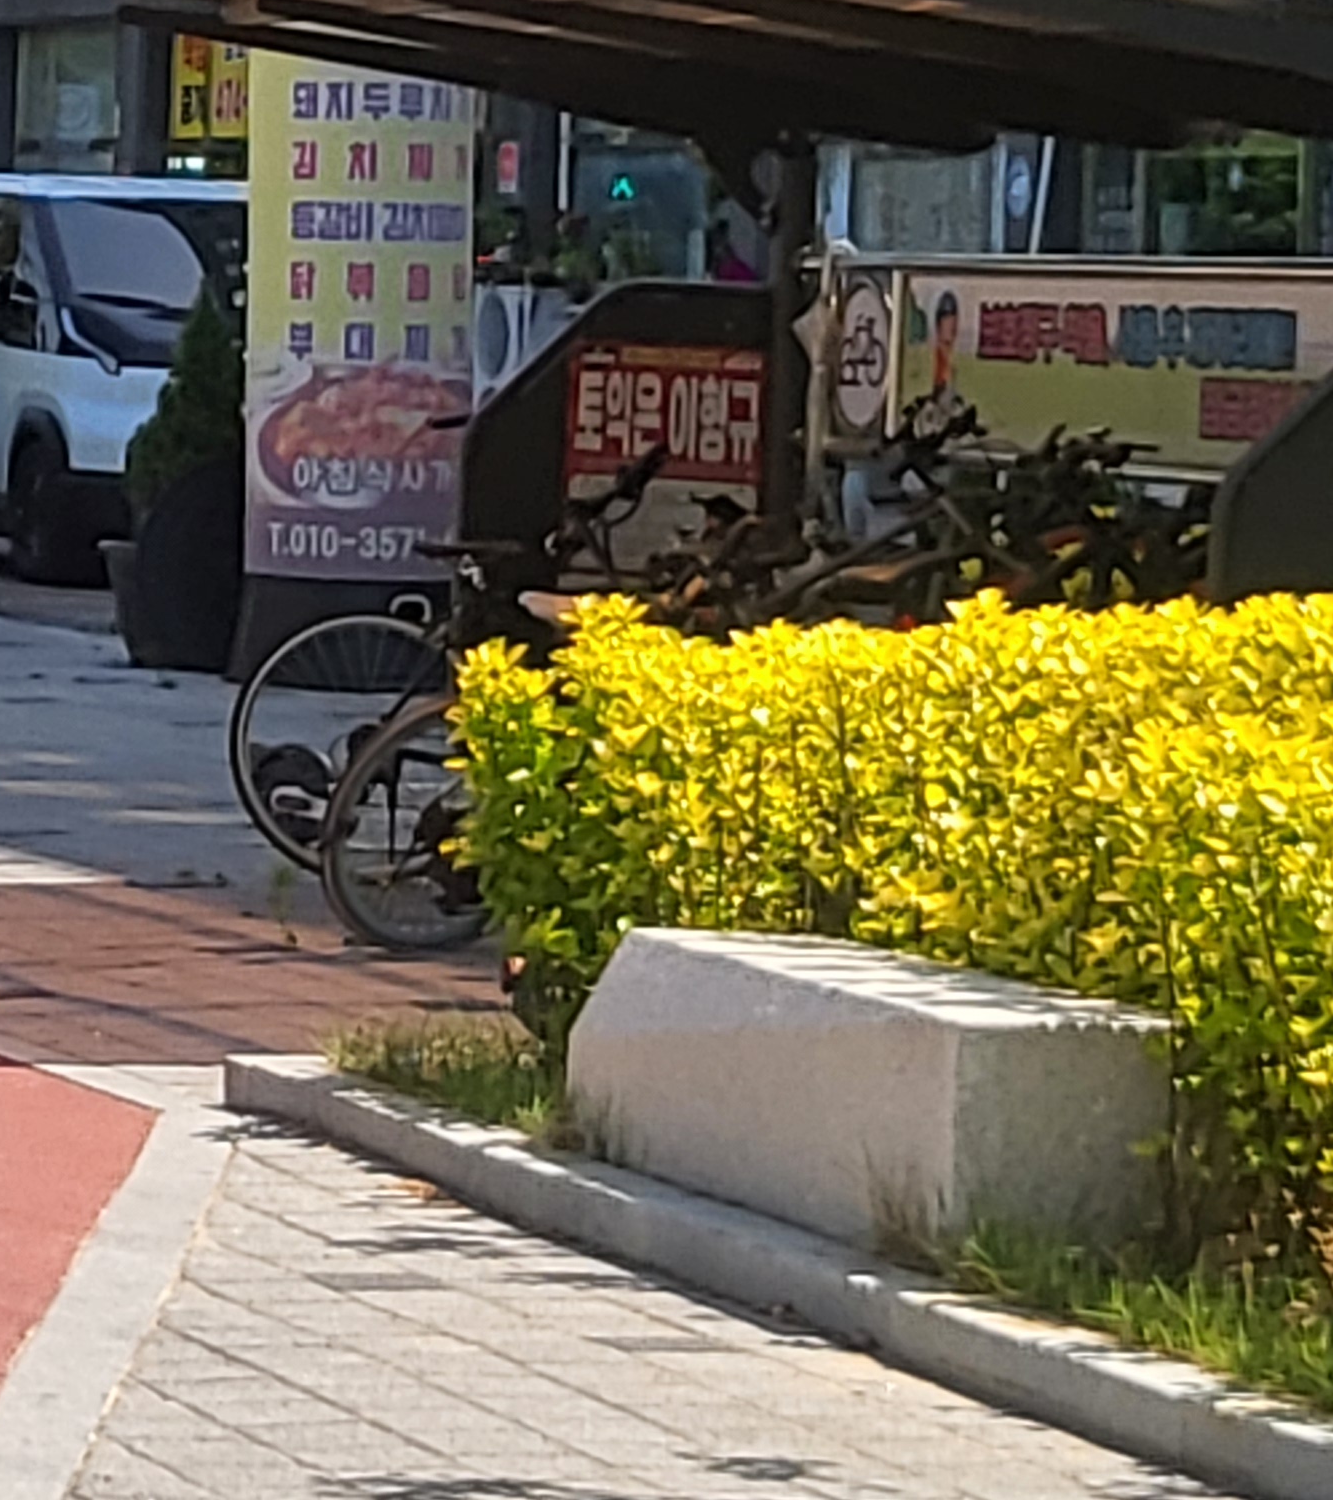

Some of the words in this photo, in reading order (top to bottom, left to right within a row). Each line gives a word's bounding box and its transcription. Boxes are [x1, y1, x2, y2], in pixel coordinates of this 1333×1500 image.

[290, 202, 374, 241] 등갈비
[574, 370, 663, 459] 토익은
[268, 522, 427, 560] T.010-357
